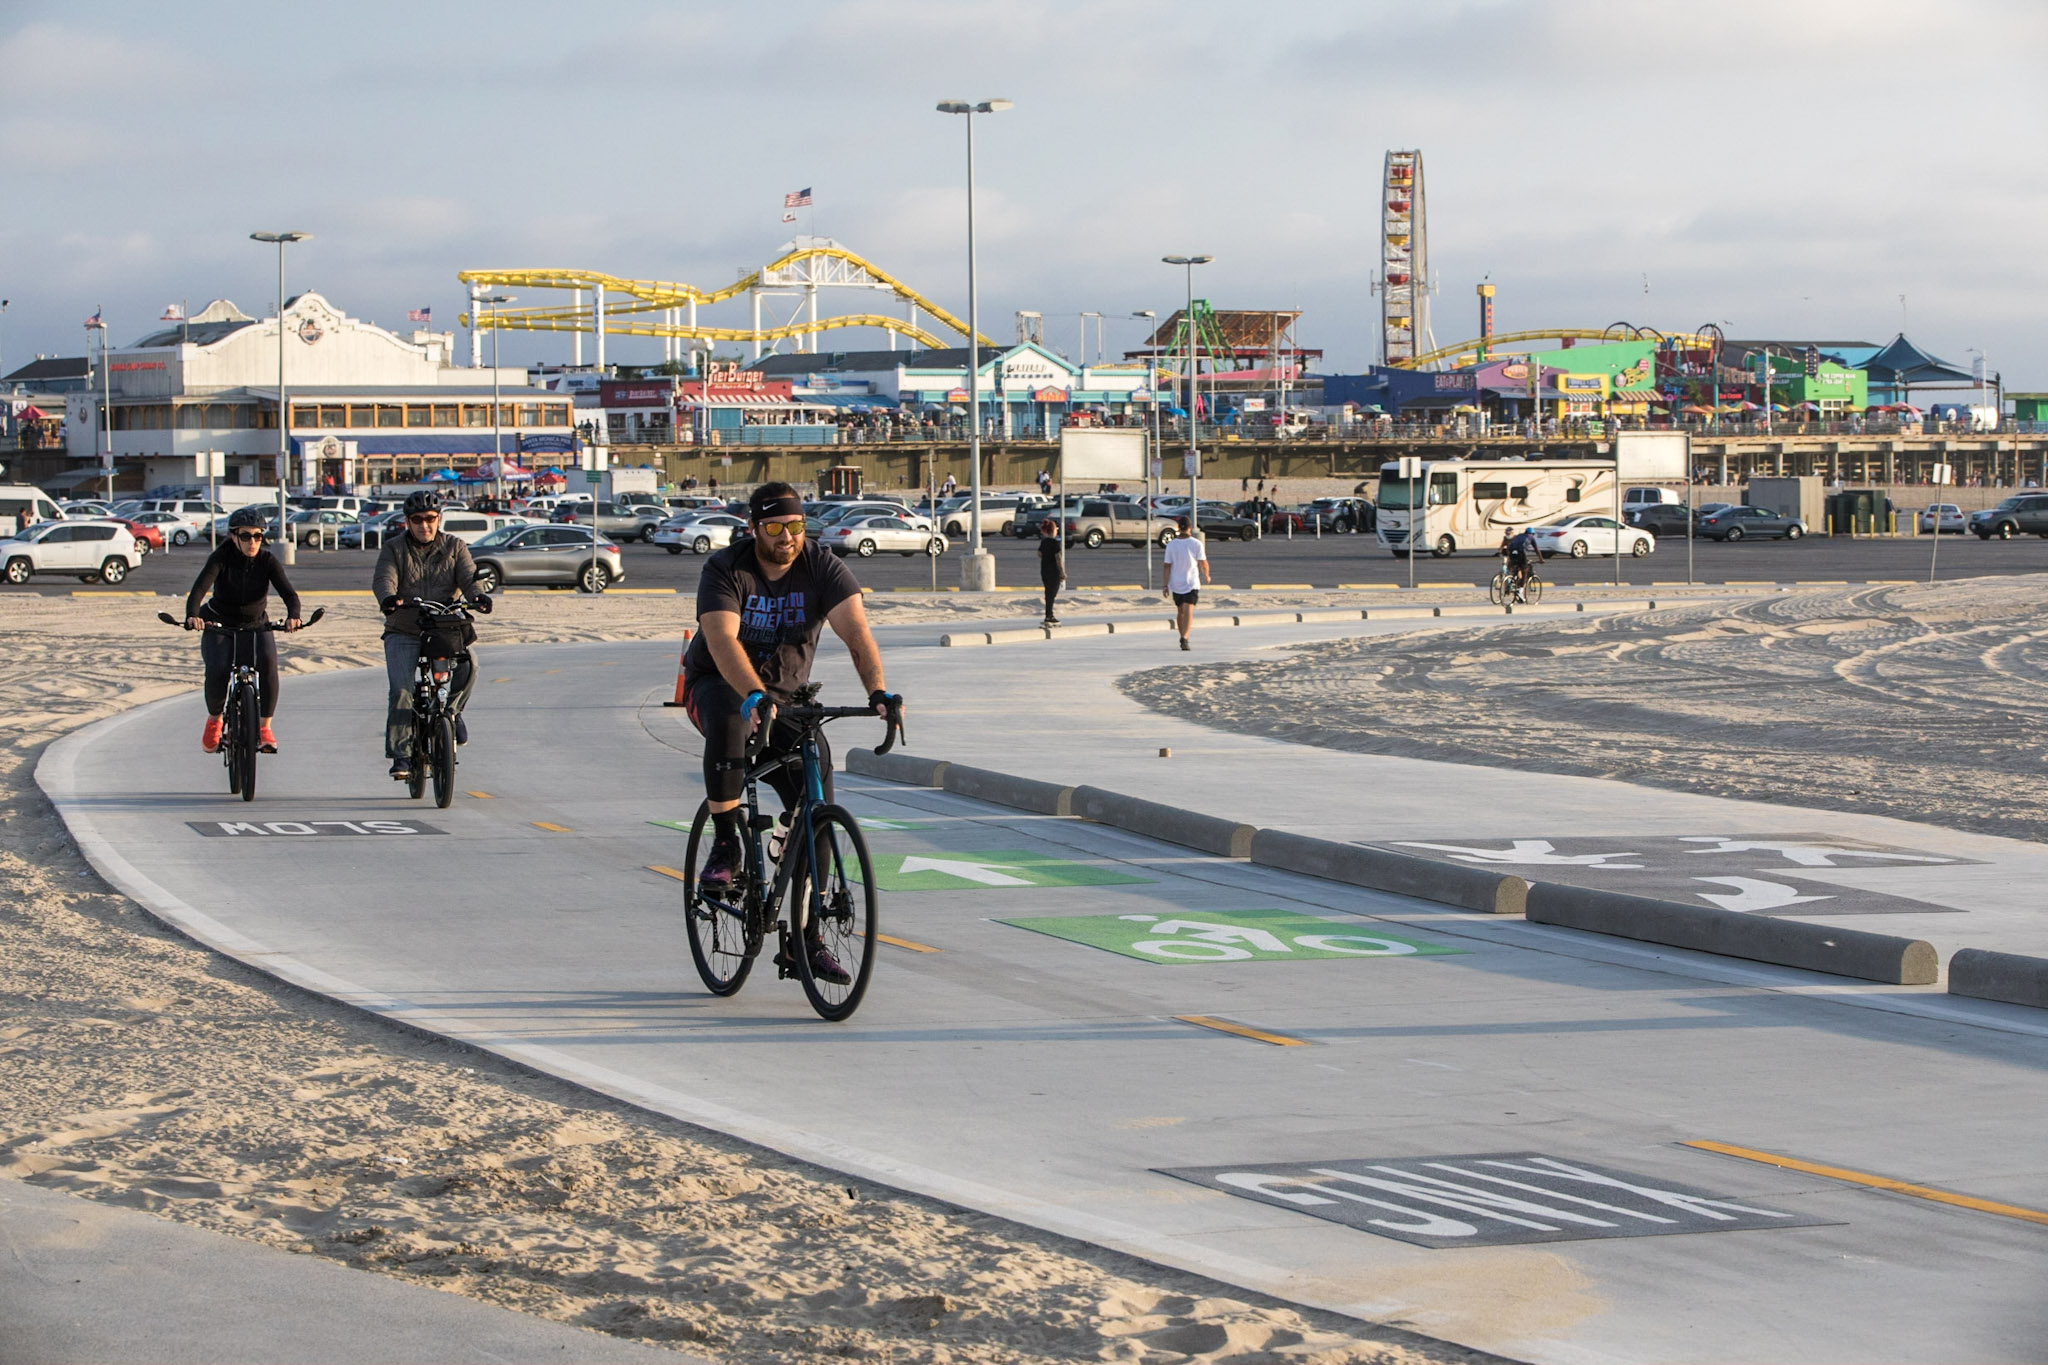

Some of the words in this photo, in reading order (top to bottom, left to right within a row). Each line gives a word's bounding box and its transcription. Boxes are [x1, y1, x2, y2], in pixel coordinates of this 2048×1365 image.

[741, 608, 806, 628] AMECA
[217, 820, 418, 835] SLOW
[1215, 1157, 1794, 1237] XING
